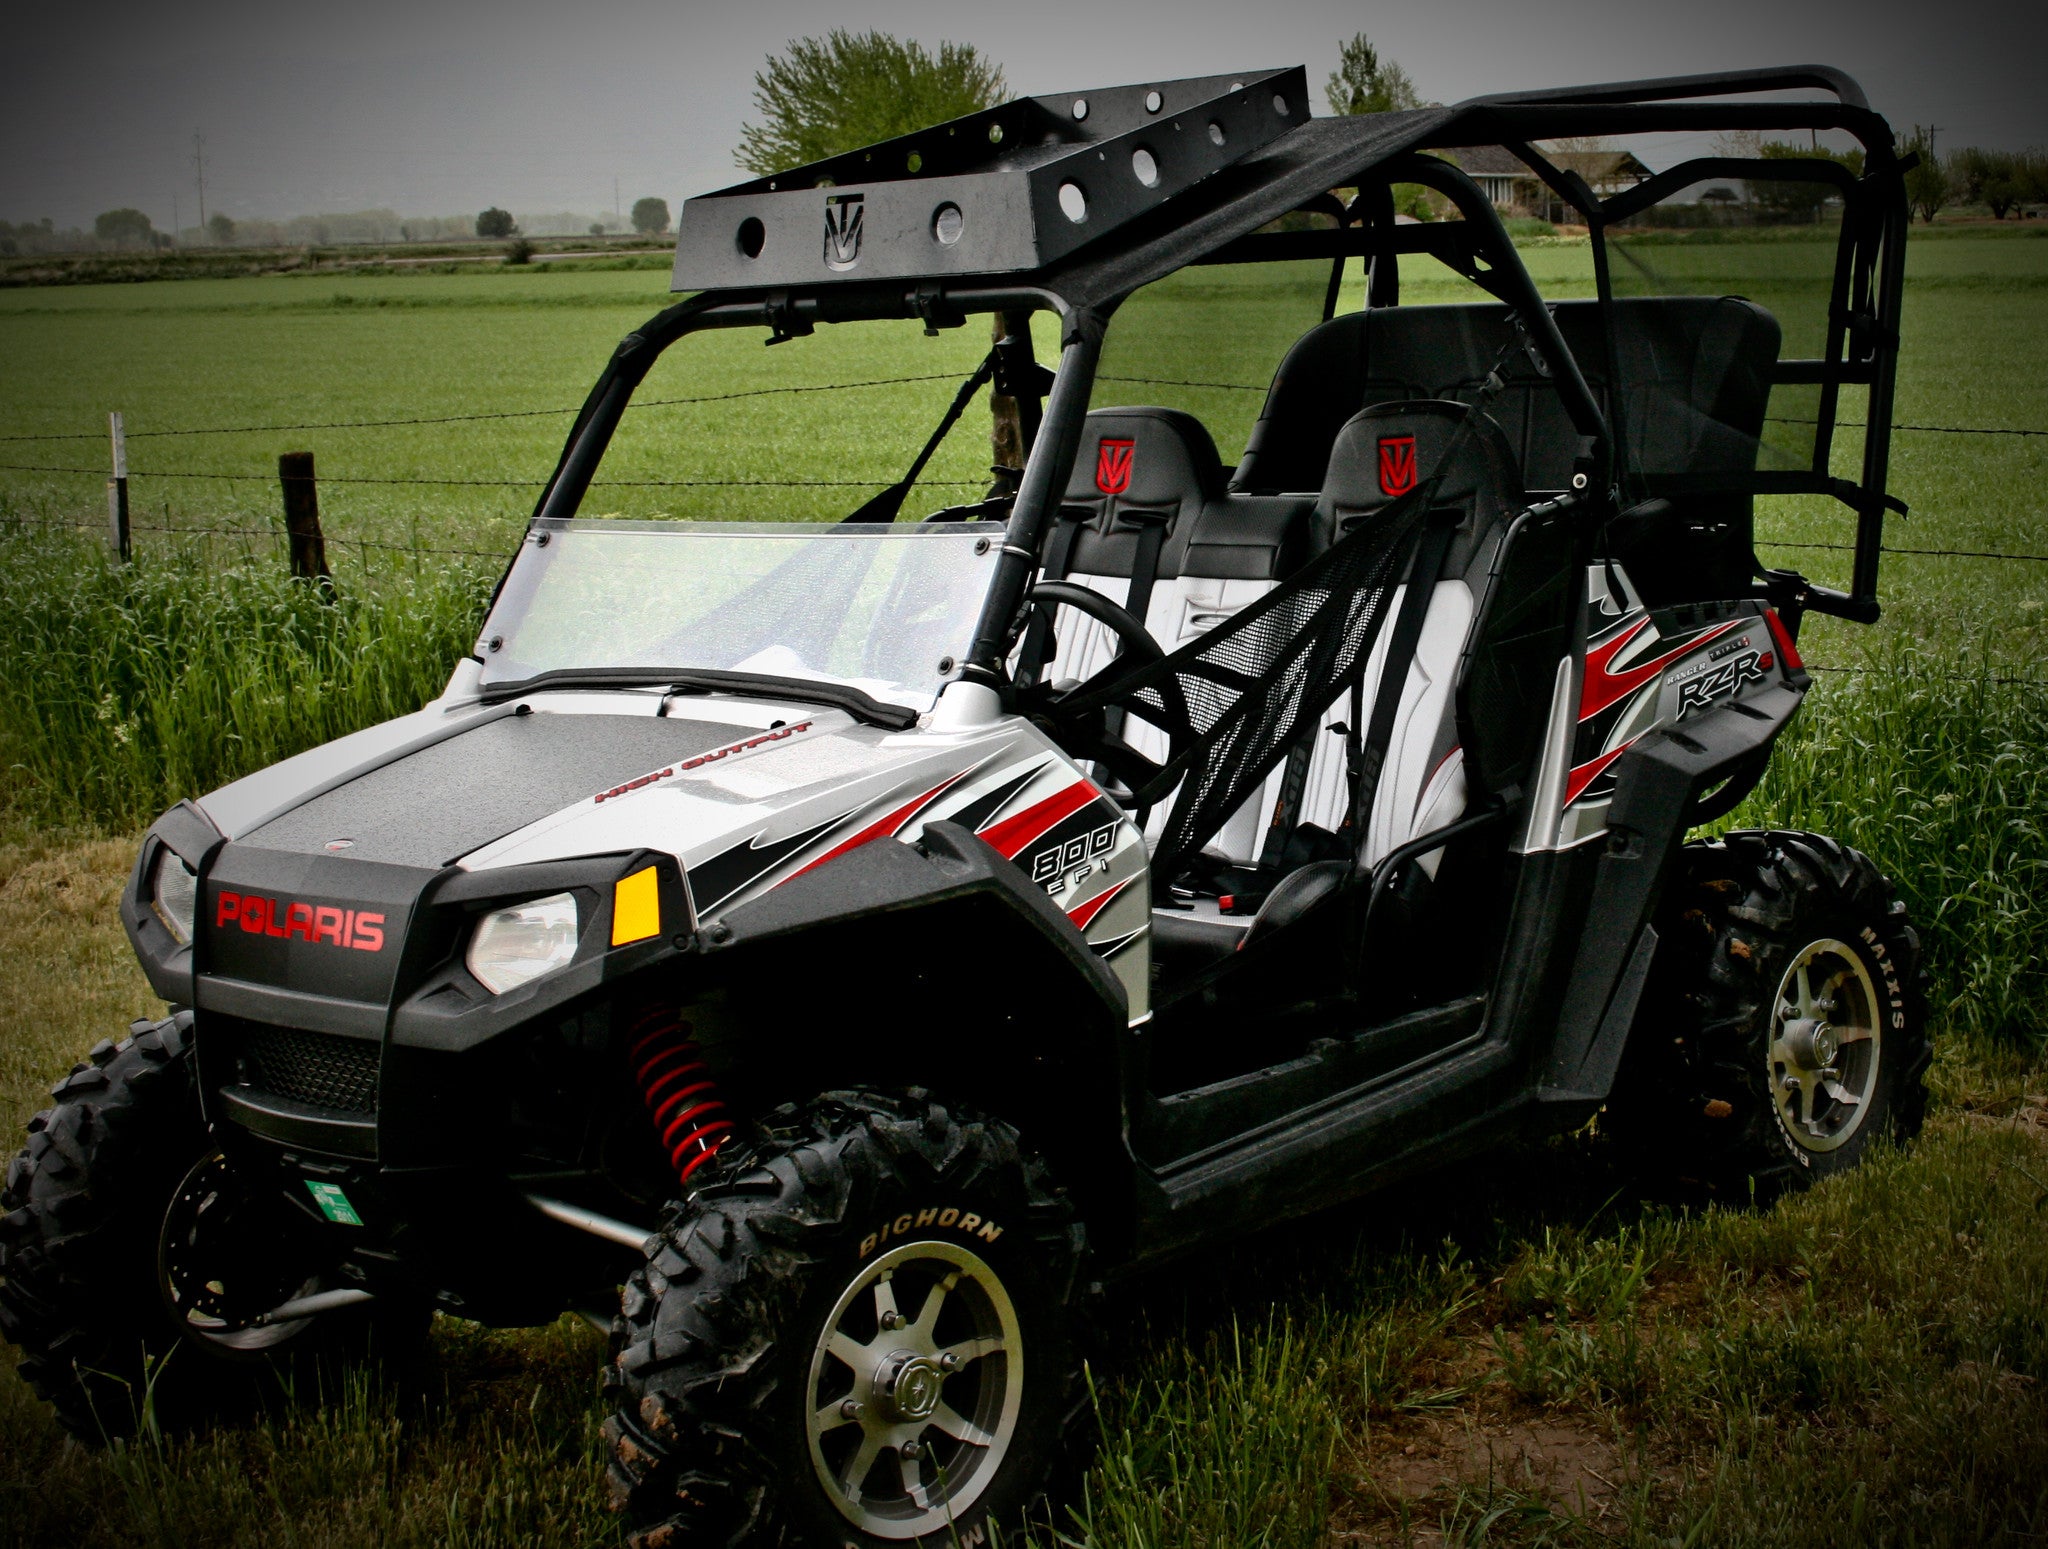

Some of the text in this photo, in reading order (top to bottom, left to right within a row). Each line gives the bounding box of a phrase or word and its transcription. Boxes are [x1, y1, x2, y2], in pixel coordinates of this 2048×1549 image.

[1667, 662, 1707, 686] RANGER
[595, 721, 813, 804] HIGH OUTPUT
[1032, 821, 1118, 883] 800
[216, 890, 386, 952] POLARIS
[1860, 926, 1905, 1029] MAXXIS
[859, 1207, 1004, 1259] BIGHORN
